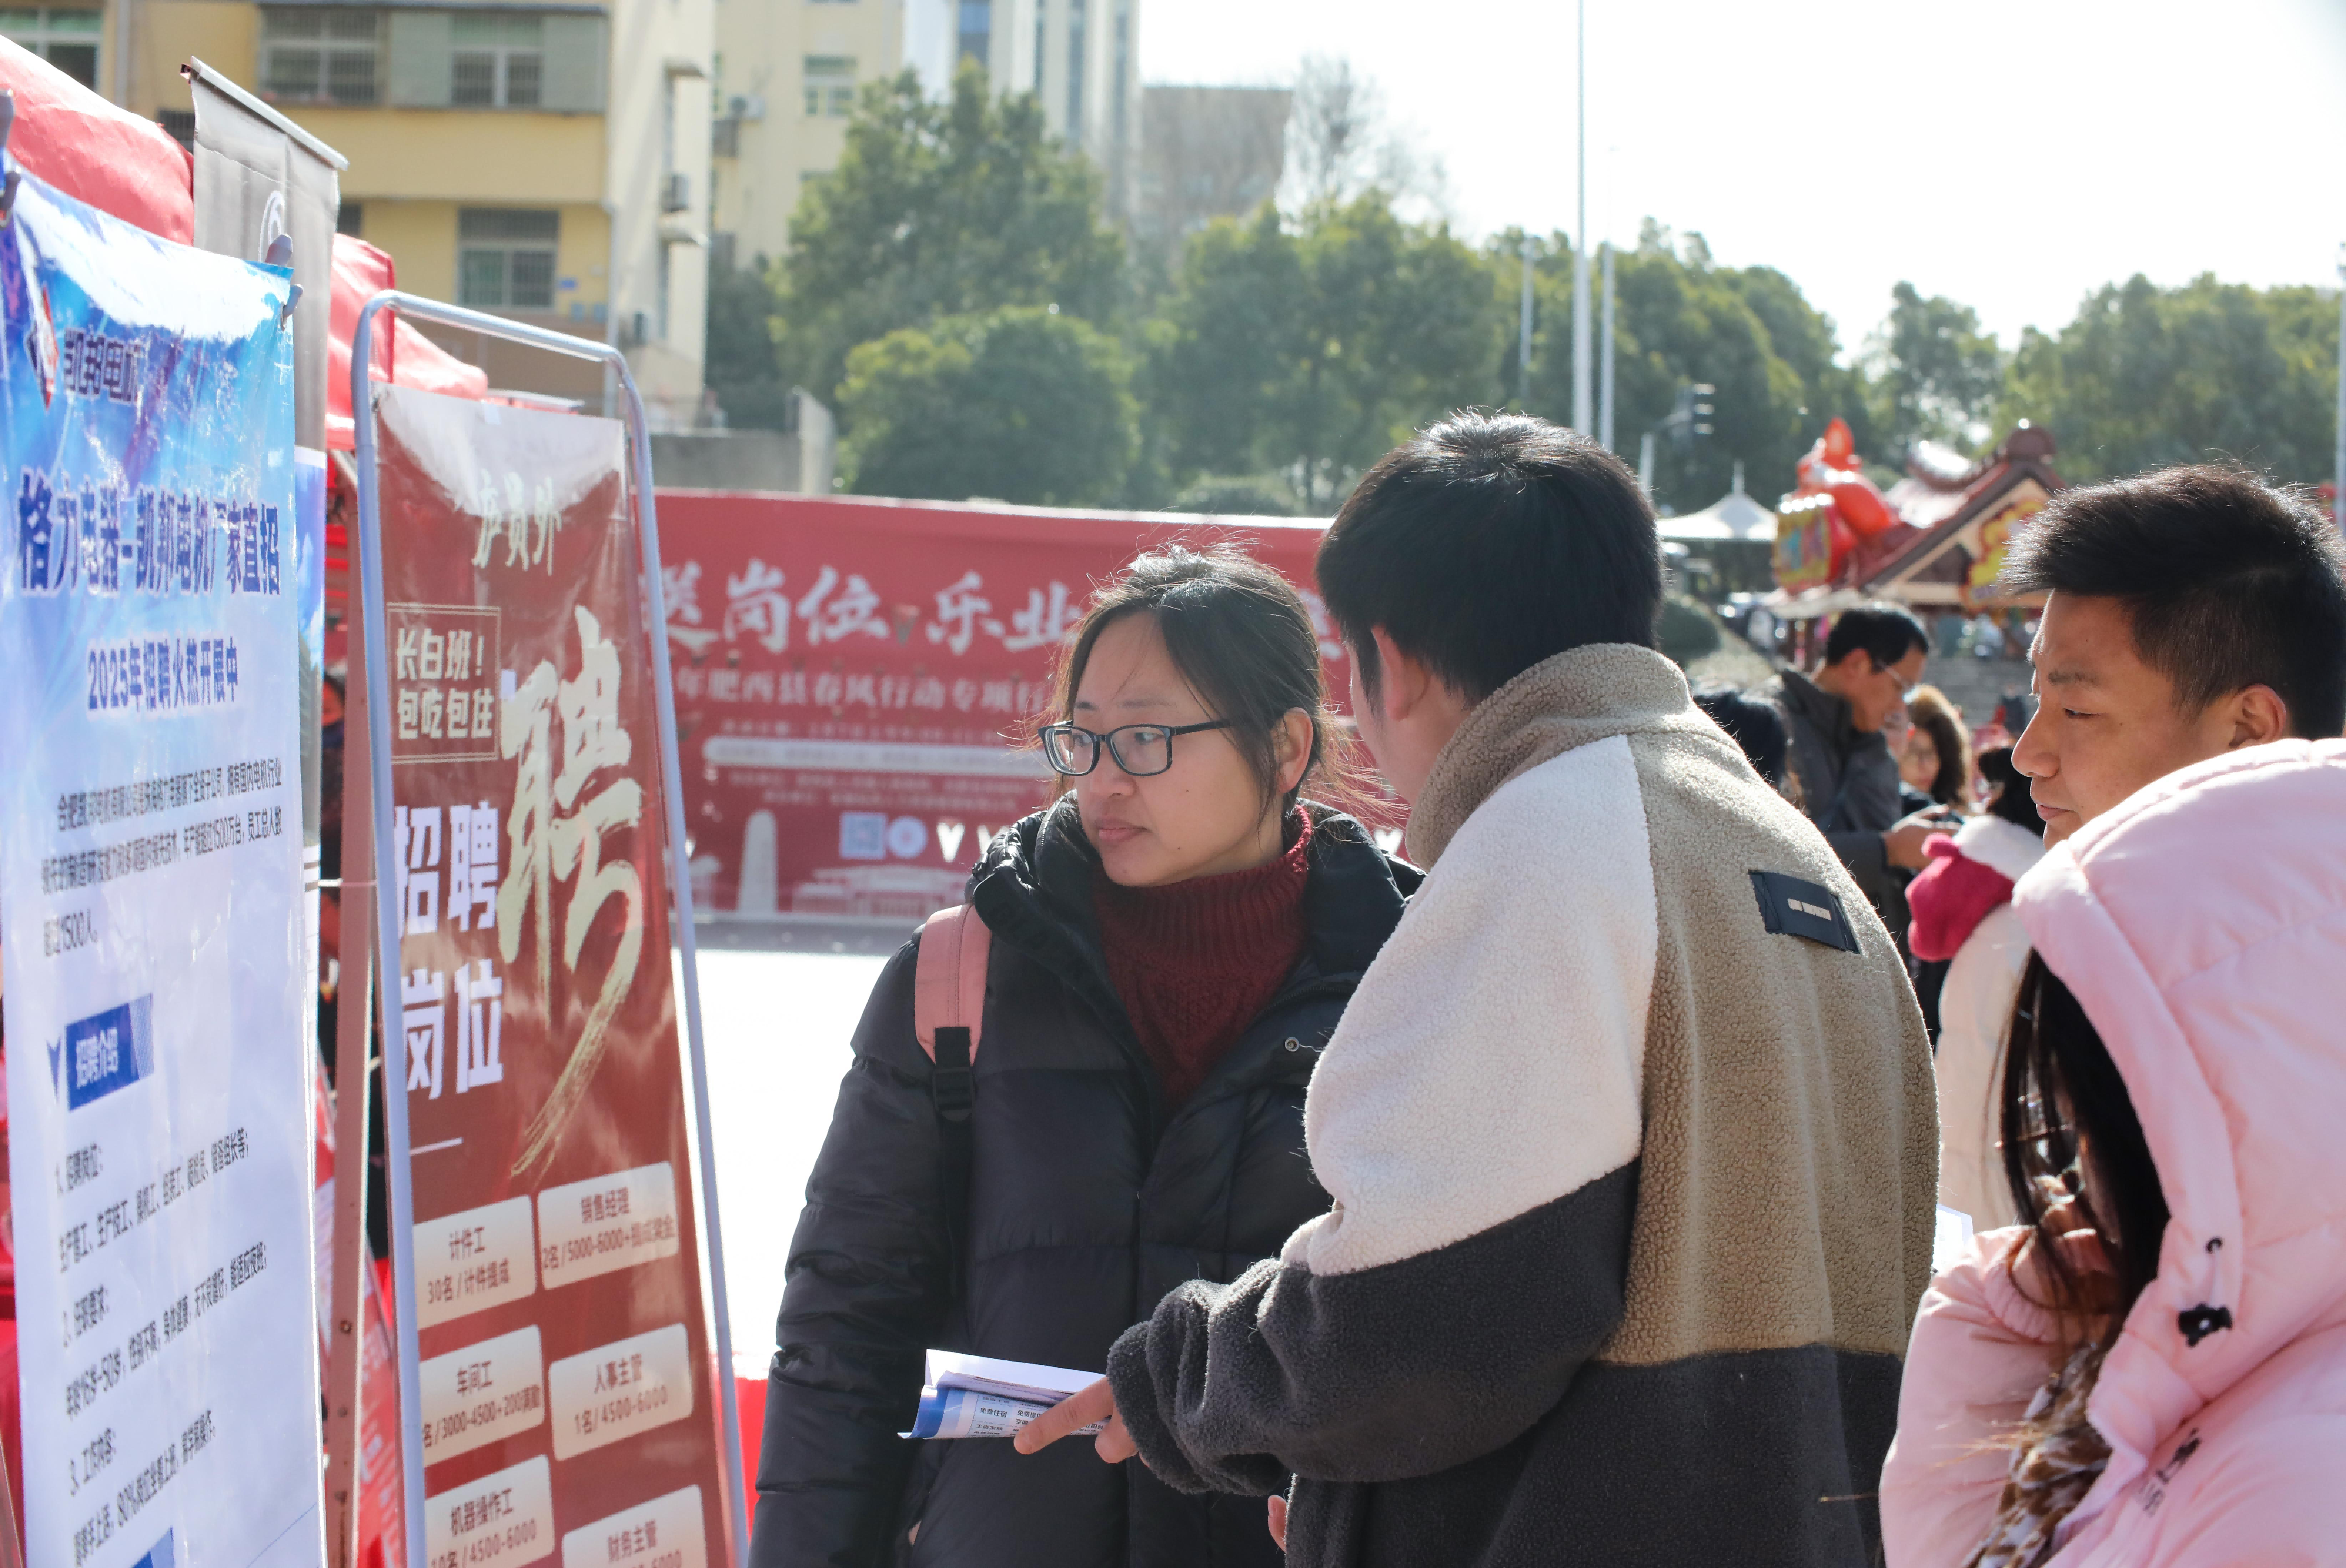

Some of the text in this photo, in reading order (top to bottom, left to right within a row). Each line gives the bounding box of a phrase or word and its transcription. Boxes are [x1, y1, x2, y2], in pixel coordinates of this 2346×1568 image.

[89, 636, 238, 712] 2025年招聘火热开展中
[397, 687, 493, 740] 包吃包住
[394, 800, 499, 939] 招聘
[401, 959, 503, 1100] 岗位
[574, 1385, 668, 1436] 1名/4500-6000
[980, 1407, 1007, 1418] 免费住宿
